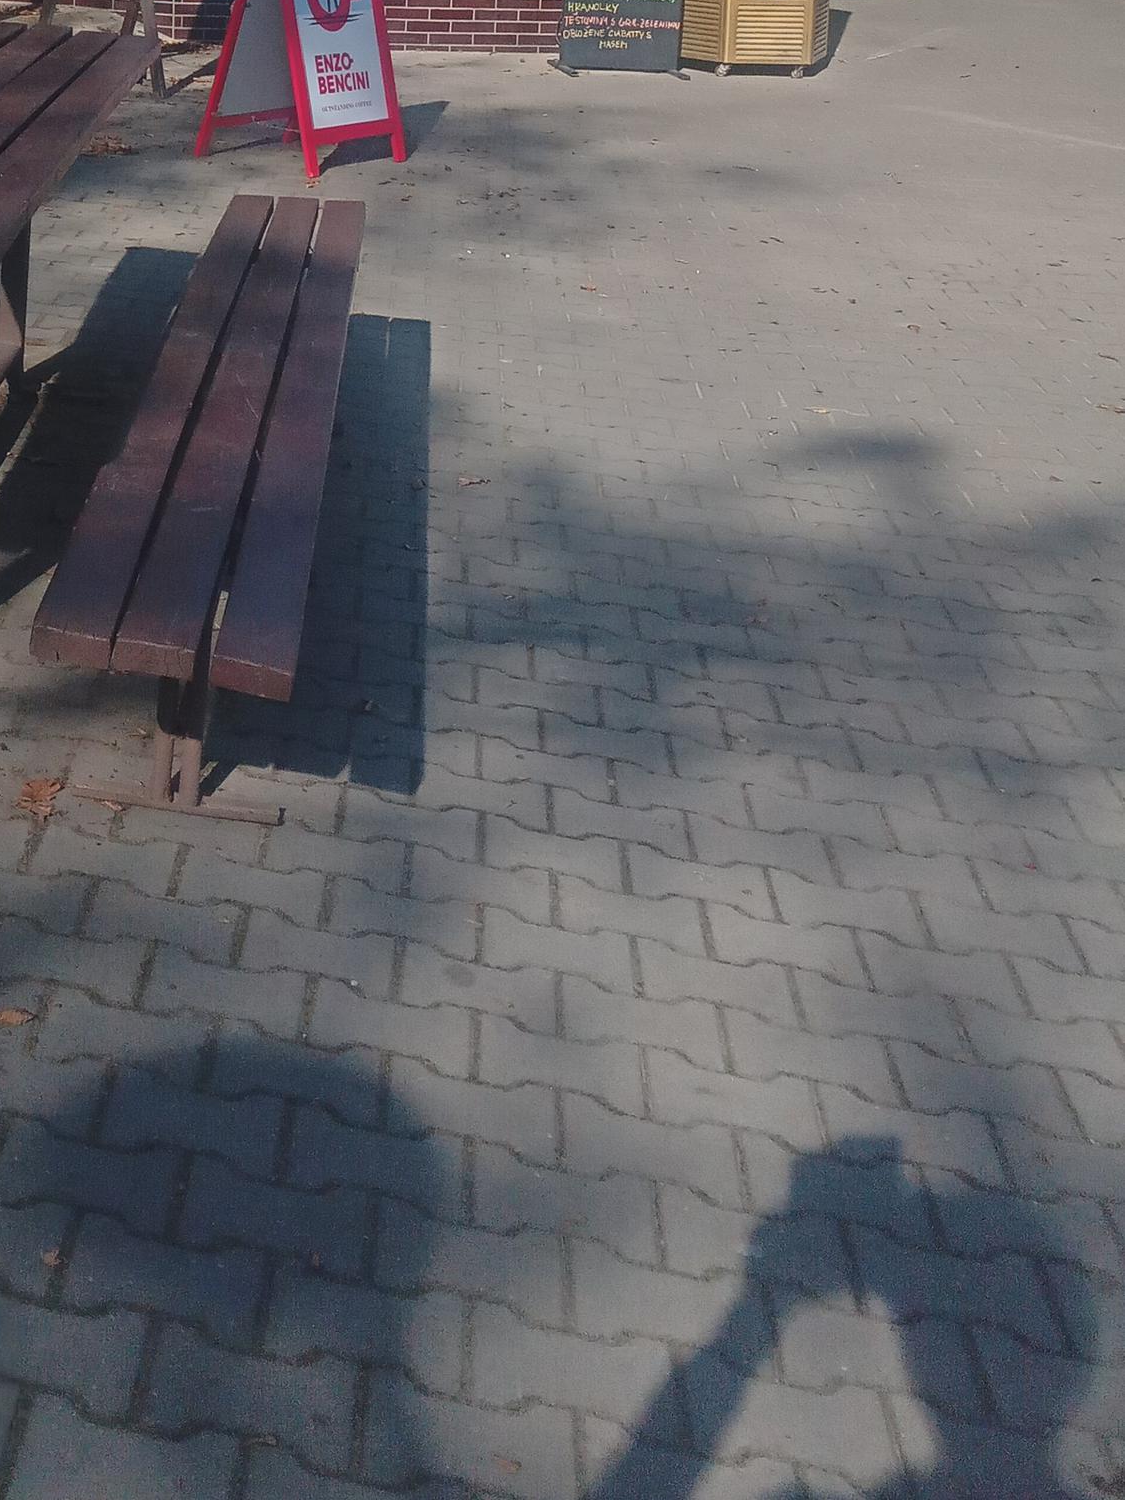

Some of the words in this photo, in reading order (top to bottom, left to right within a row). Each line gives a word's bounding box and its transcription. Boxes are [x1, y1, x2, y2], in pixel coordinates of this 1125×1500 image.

[568, 1, 620, 14] HRANOLKY
[314, 52, 354, 74] ENZO
[317, 71, 370, 94] BENCINI
